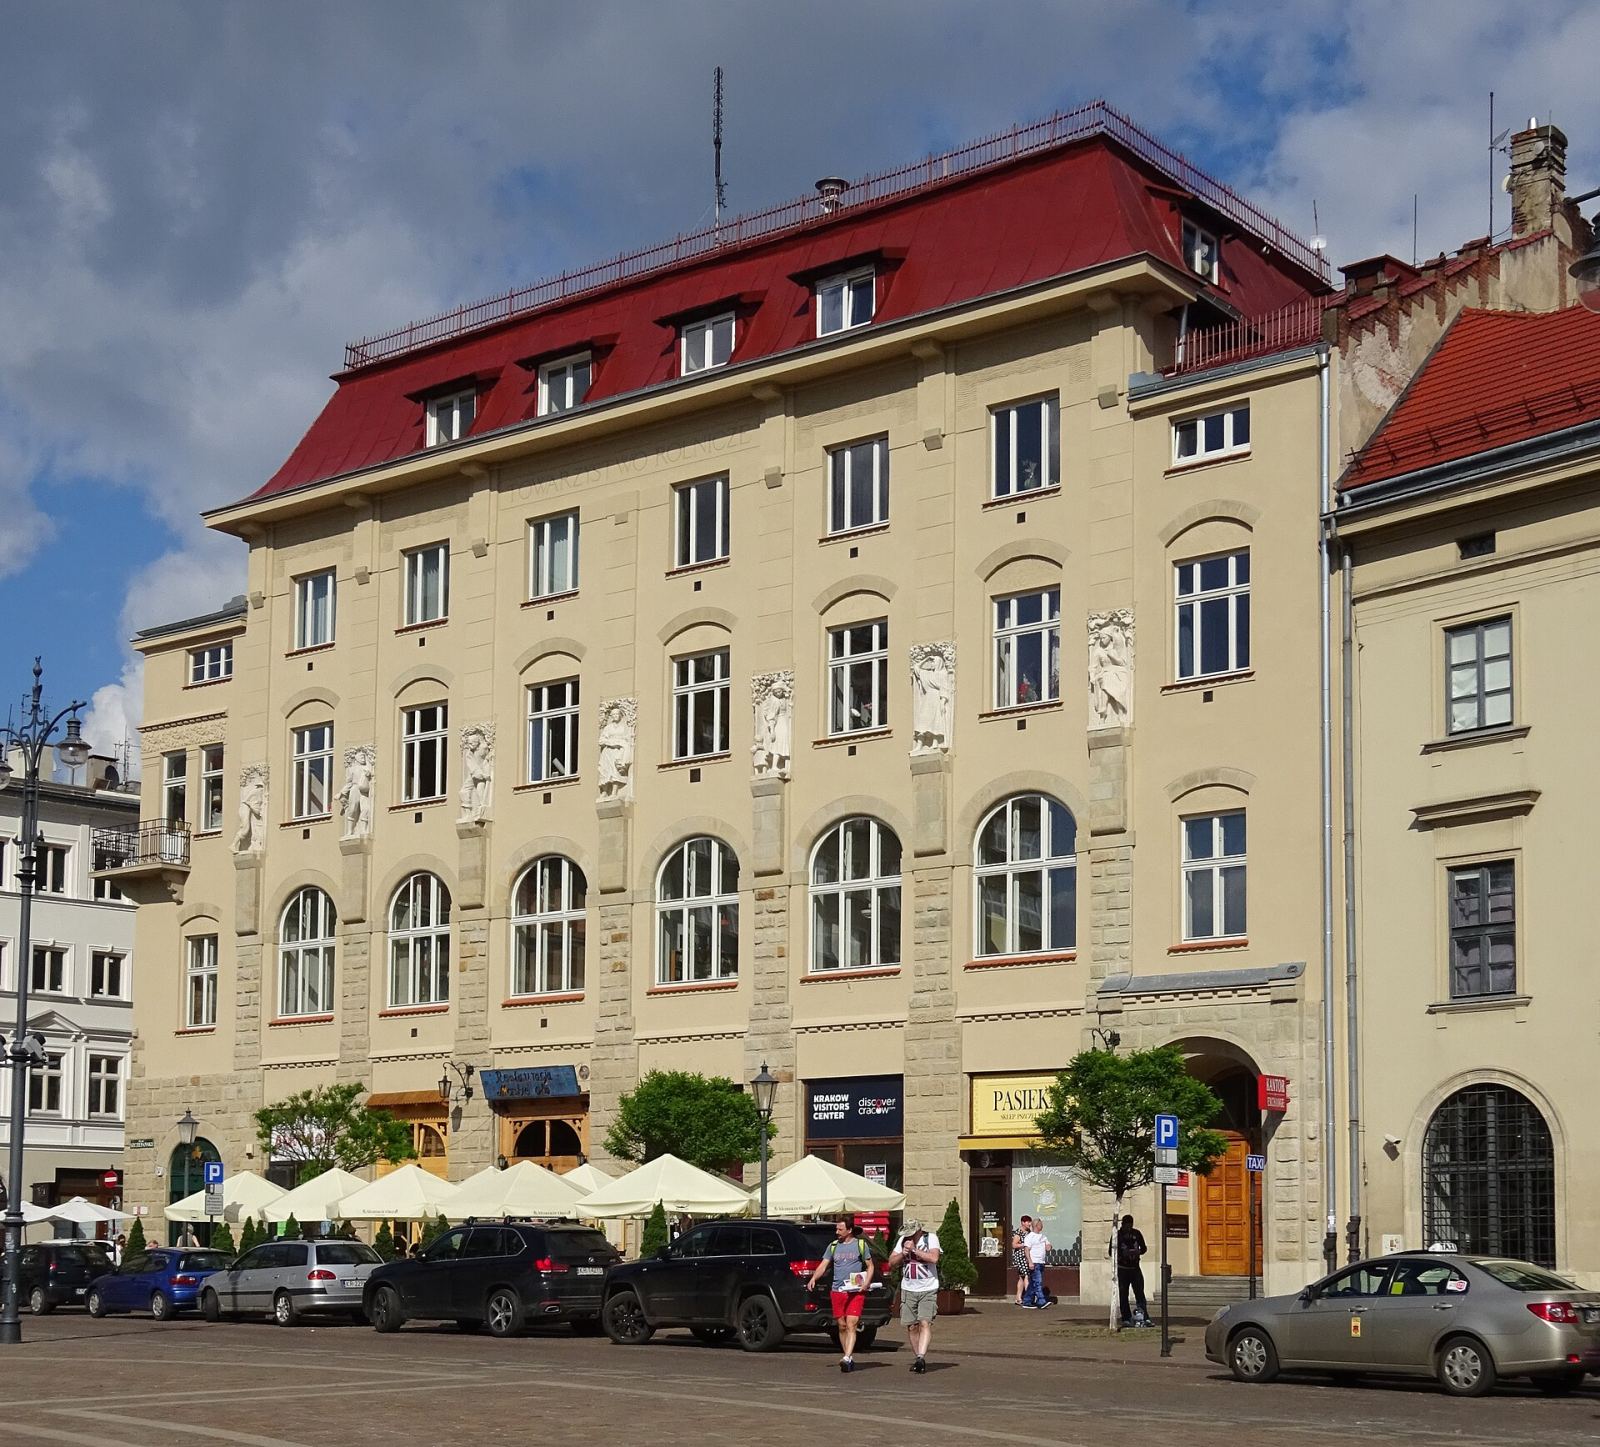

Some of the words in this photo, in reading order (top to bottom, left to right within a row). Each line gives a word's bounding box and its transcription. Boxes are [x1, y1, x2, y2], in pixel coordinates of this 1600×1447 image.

[1266, 1078, 1285, 1093] KANTOR
[813, 1094, 849, 1103] KRAKOW
[858, 1097, 896, 1107] discover
[993, 1088, 1053, 1111] PASIEK
[813, 1103, 850, 1112] VISITORS
[858, 1107, 890, 1115] cracow
[812, 1111, 845, 1120] CENTER
[1161, 1119, 1174, 1144] P
[1247, 1157, 1264, 1169] TAXI
[209, 1165, 220, 1181] P
[1440, 1242, 1457, 1251] TAXI
